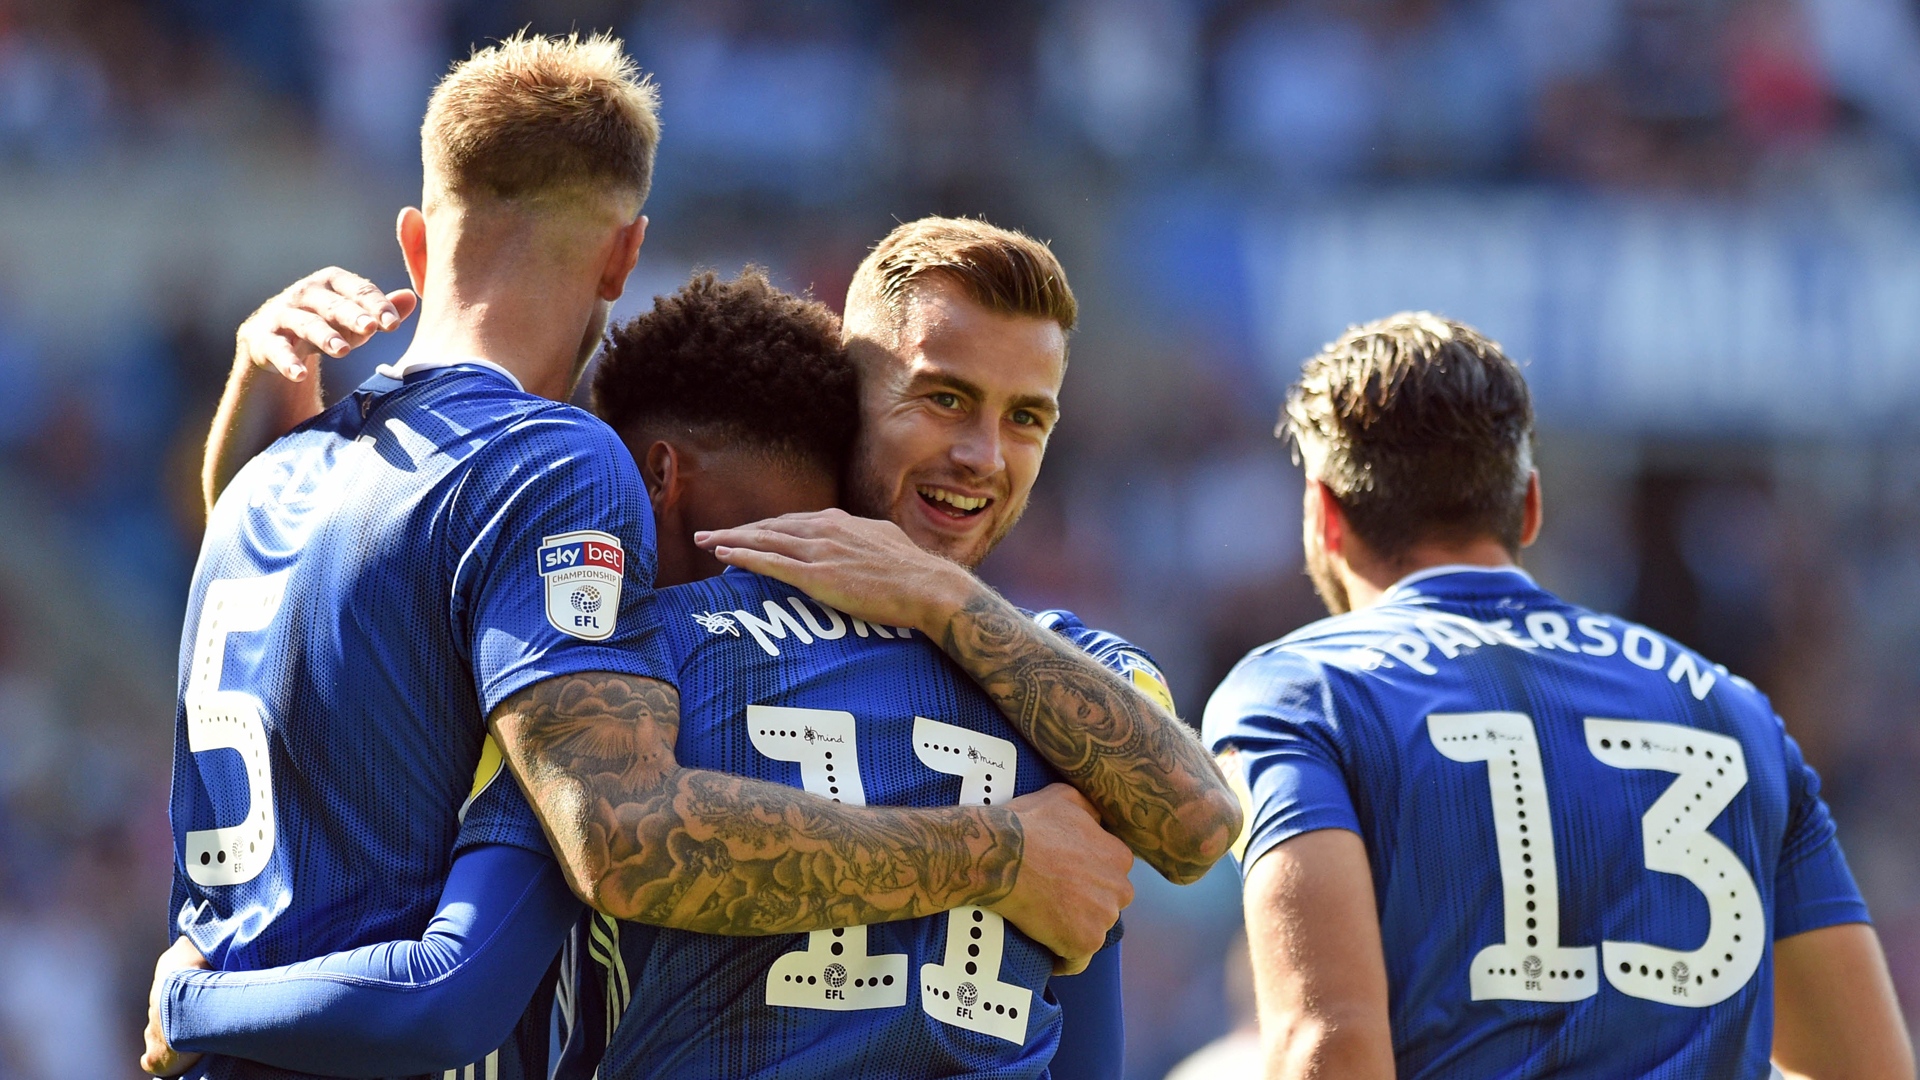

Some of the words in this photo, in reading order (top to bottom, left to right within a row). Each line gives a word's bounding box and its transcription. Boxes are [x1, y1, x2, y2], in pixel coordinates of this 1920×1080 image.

[545, 547, 580, 568] sky
[588, 543, 620, 568] bet
[552, 570, 617, 583] CHAMPIONSHIP
[574, 615, 600, 629] EFL
[735, 596, 912, 657] MU
[184, 567, 290, 887] 5
[817, 734, 845, 744] mind
[980, 755, 1006, 770] mind
[1427, 711, 1766, 1008] 13
[1525, 980, 1543, 991] EFL
[1672, 985, 1689, 997] EFL
[825, 989, 845, 1000] EFL
[956, 1006, 973, 1020] EFL
